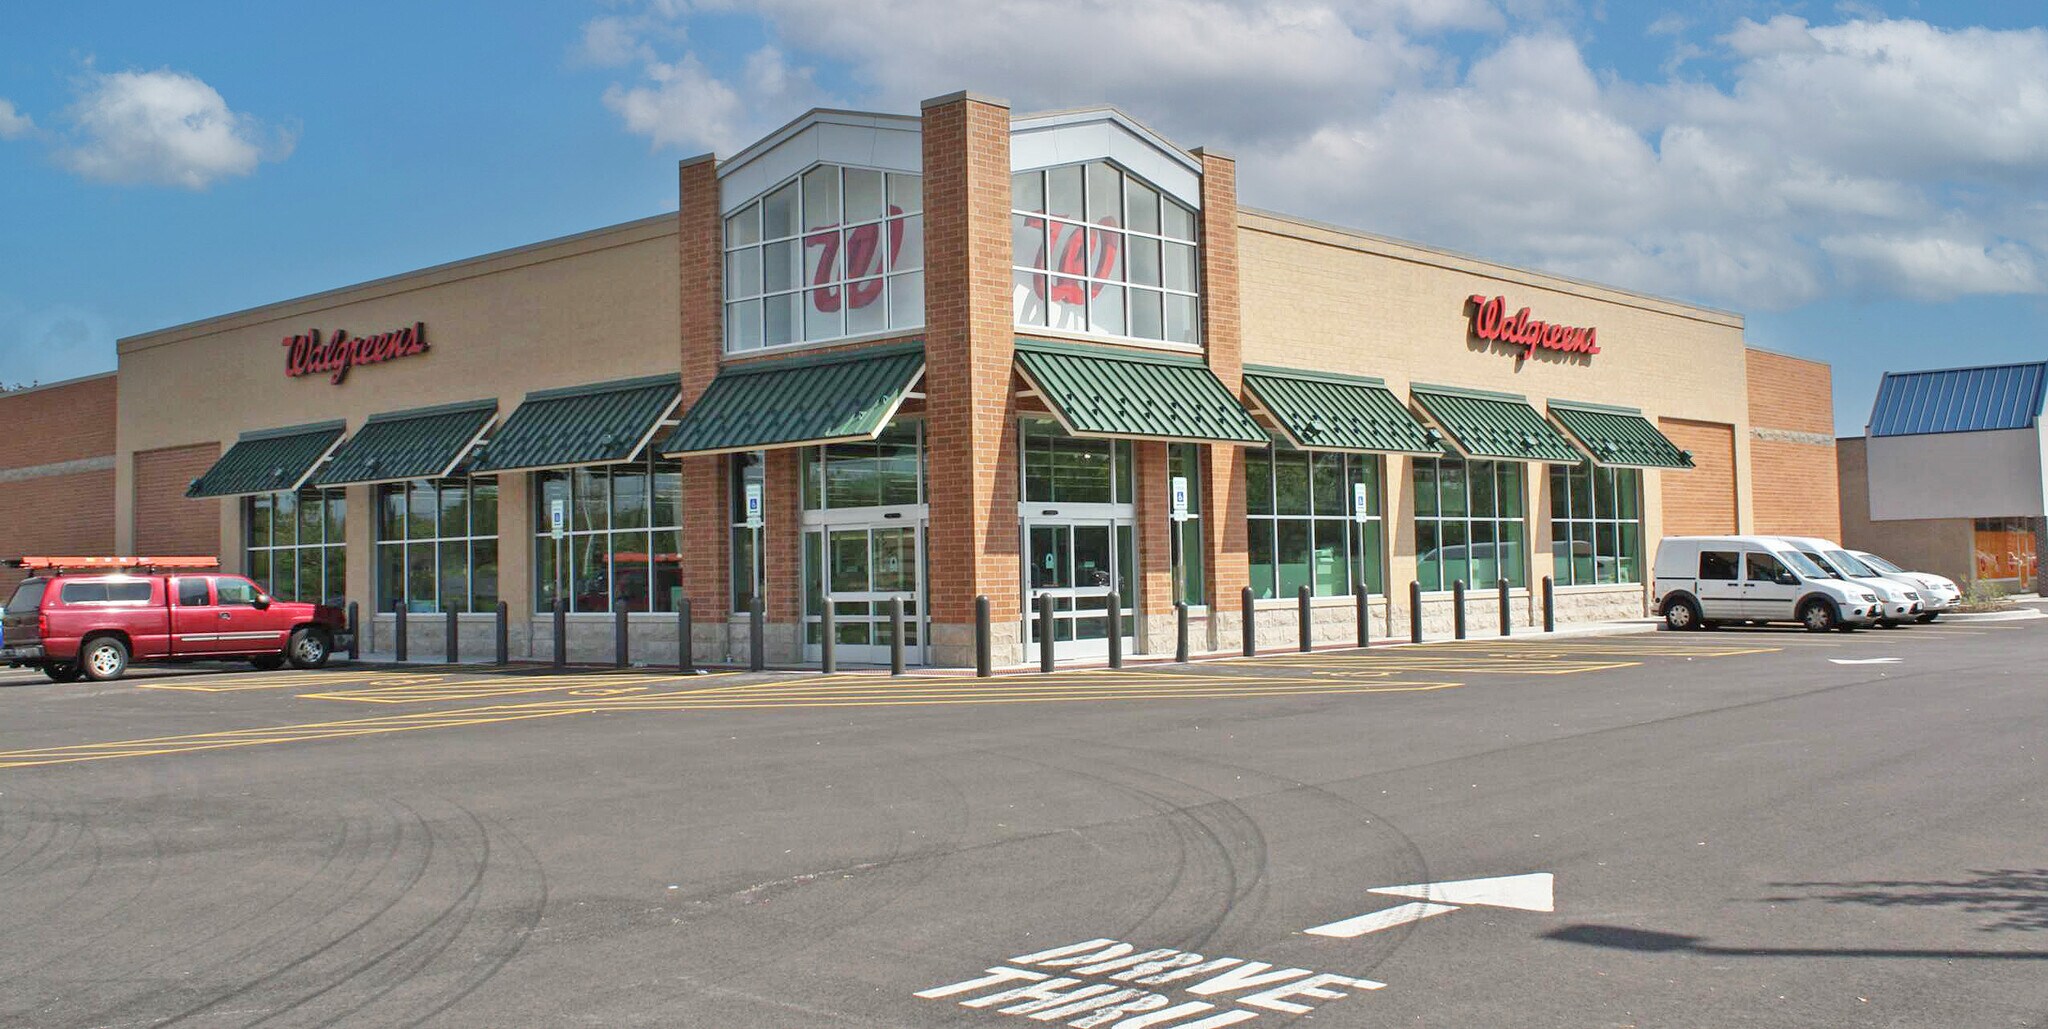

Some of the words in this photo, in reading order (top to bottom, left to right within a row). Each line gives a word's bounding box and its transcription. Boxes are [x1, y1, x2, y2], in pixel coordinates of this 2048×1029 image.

[805, 205, 904, 313] W
[1022, 208, 1119, 305] W
[282, 322, 429, 385] Walgreens
[1471, 294, 1601, 361] Walgreens
[1007, 938, 1388, 1013] DRIVE
